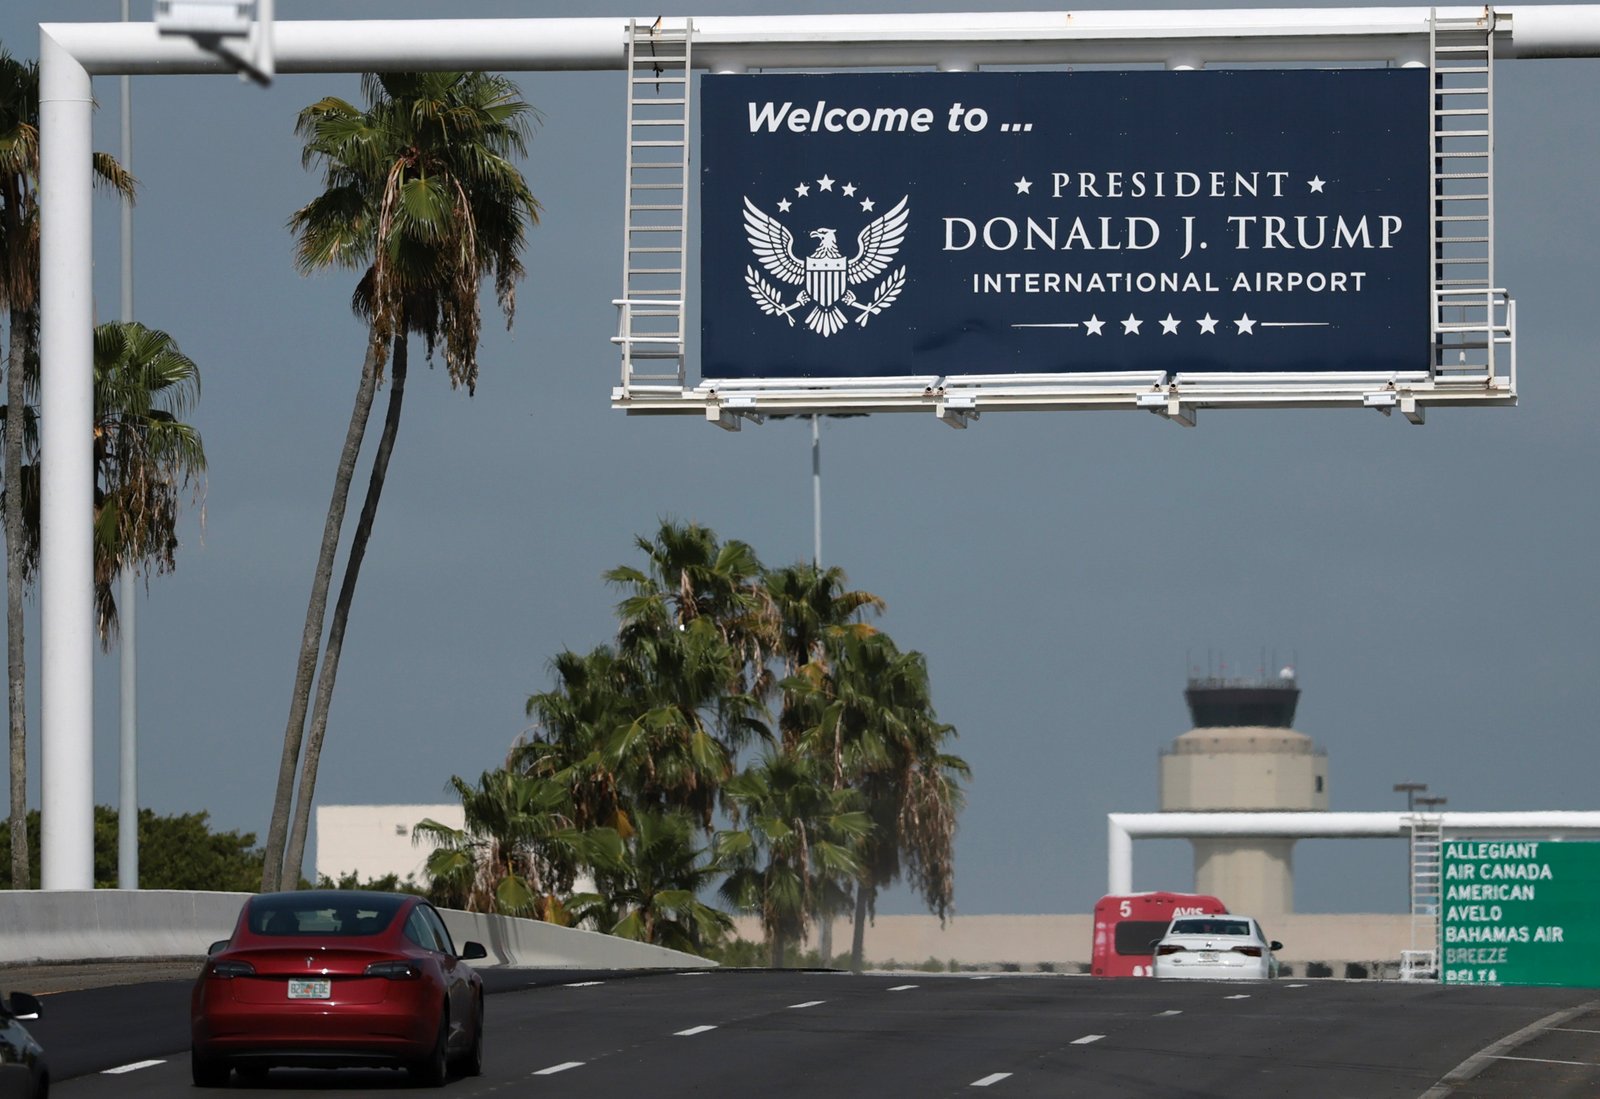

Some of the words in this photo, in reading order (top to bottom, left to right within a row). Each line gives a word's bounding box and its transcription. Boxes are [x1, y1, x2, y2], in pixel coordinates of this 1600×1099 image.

[749, 100, 935, 134] Welcome
[948, 103, 990, 134] to
[1052, 171, 1290, 199] PRESIDENT
[942, 216, 1161, 252] DONALD
[1180, 216, 1209, 260] J.
[1227, 214, 1404, 251] TRUMP
[972, 271, 1221, 294] INTERNATIONAL
[1232, 271, 1368, 293] AIRPORT
[1445, 842, 1540, 860] ALLEGIANT
[1445, 863, 1476, 881] AIR
[1480, 863, 1553, 881] CANADA
[1446, 884, 1536, 902] AMERICAN
[1119, 900, 1132, 918] 5
[1171, 906, 1204, 919] AVIS
[1446, 905, 1503, 922] AVELO
[1445, 926, 1530, 943] BAHAMAS
[1533, 926, 1565, 943] AIR
[1446, 947, 1508, 965] BREEZE
